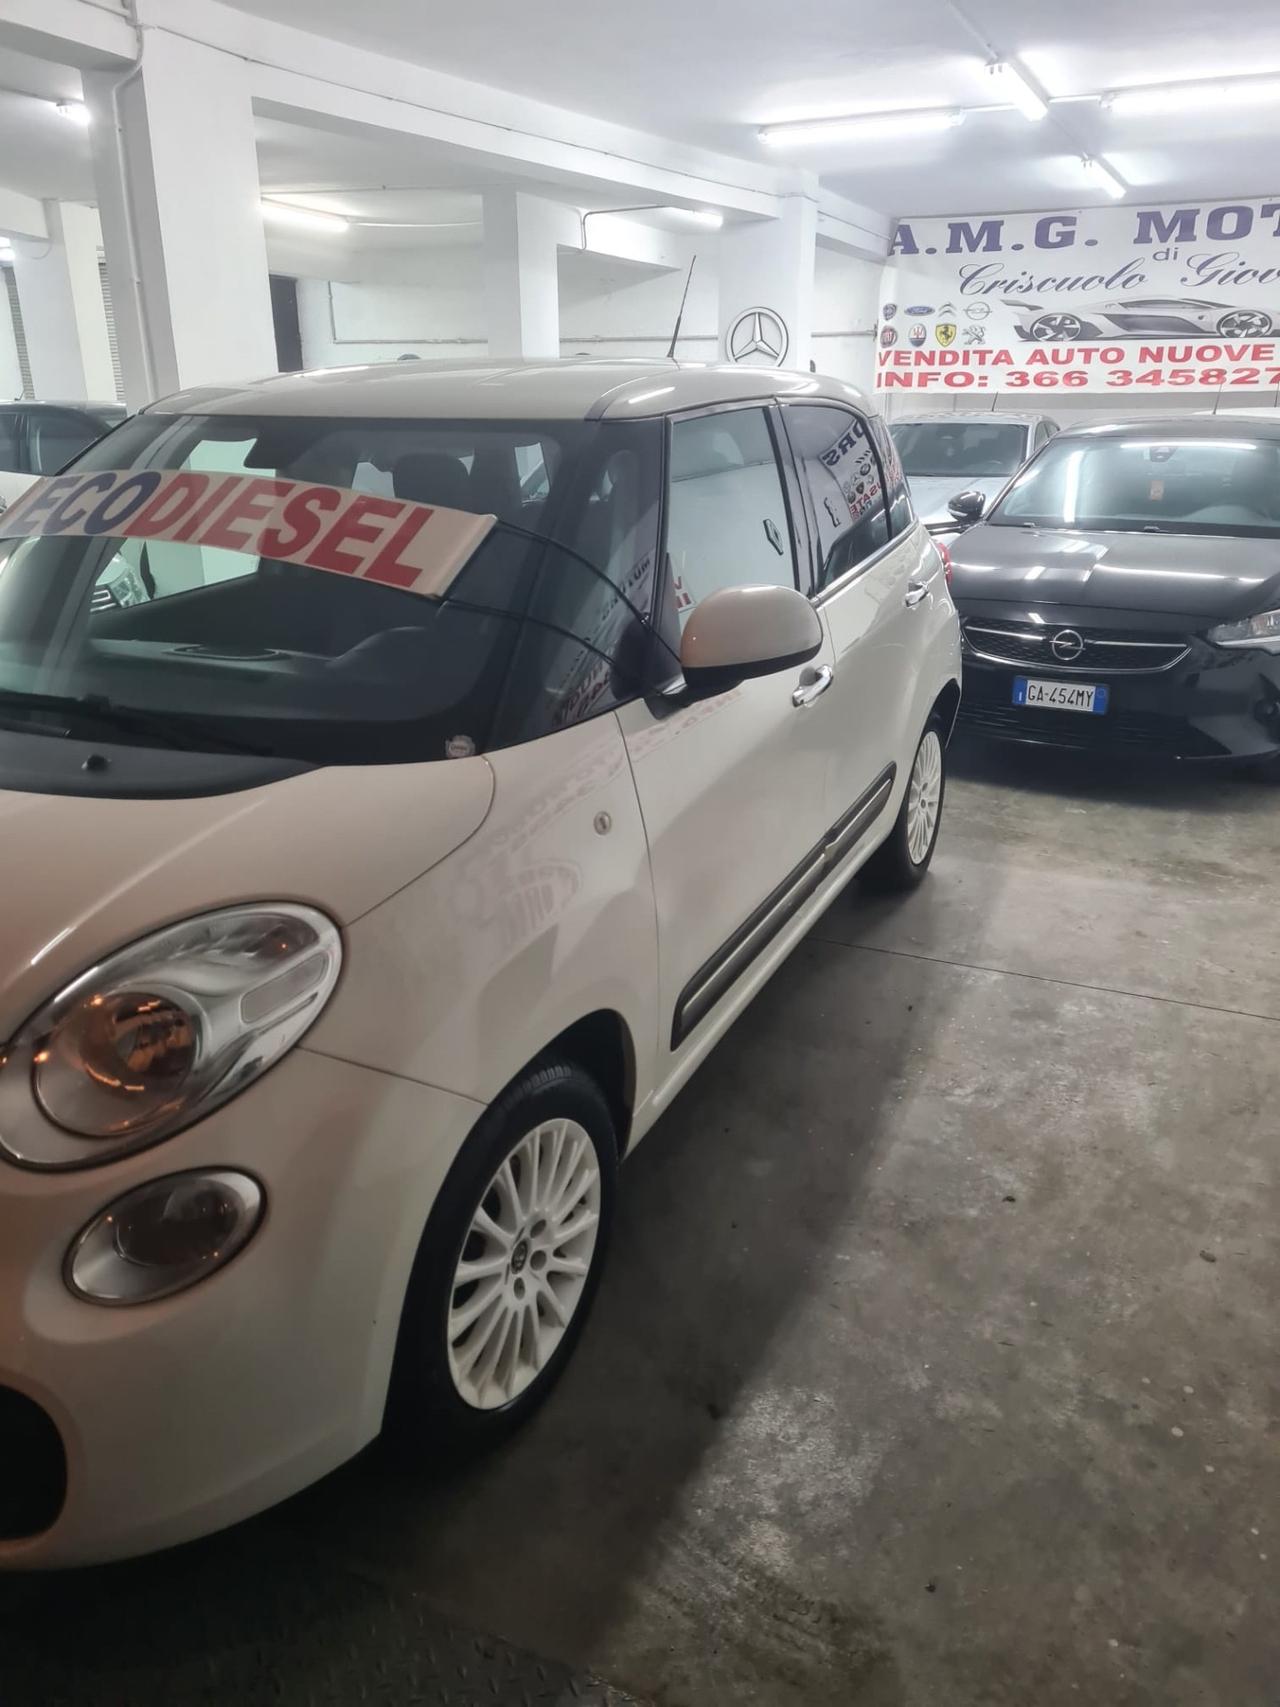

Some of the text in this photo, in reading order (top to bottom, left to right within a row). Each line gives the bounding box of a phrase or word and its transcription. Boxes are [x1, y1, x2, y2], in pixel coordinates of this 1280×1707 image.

[888, 215, 1099, 256] A.M.G.
[1153, 247, 1179, 262] di
[959, 256, 1149, 296] Criscuolo
[878, 344, 1276, 367] VENDITA AUTO NUOVE
[876, 371, 989, 388] INFO:
[1005, 370, 1089, 388] 366
[5, 472, 433, 588] ECODIESEL
